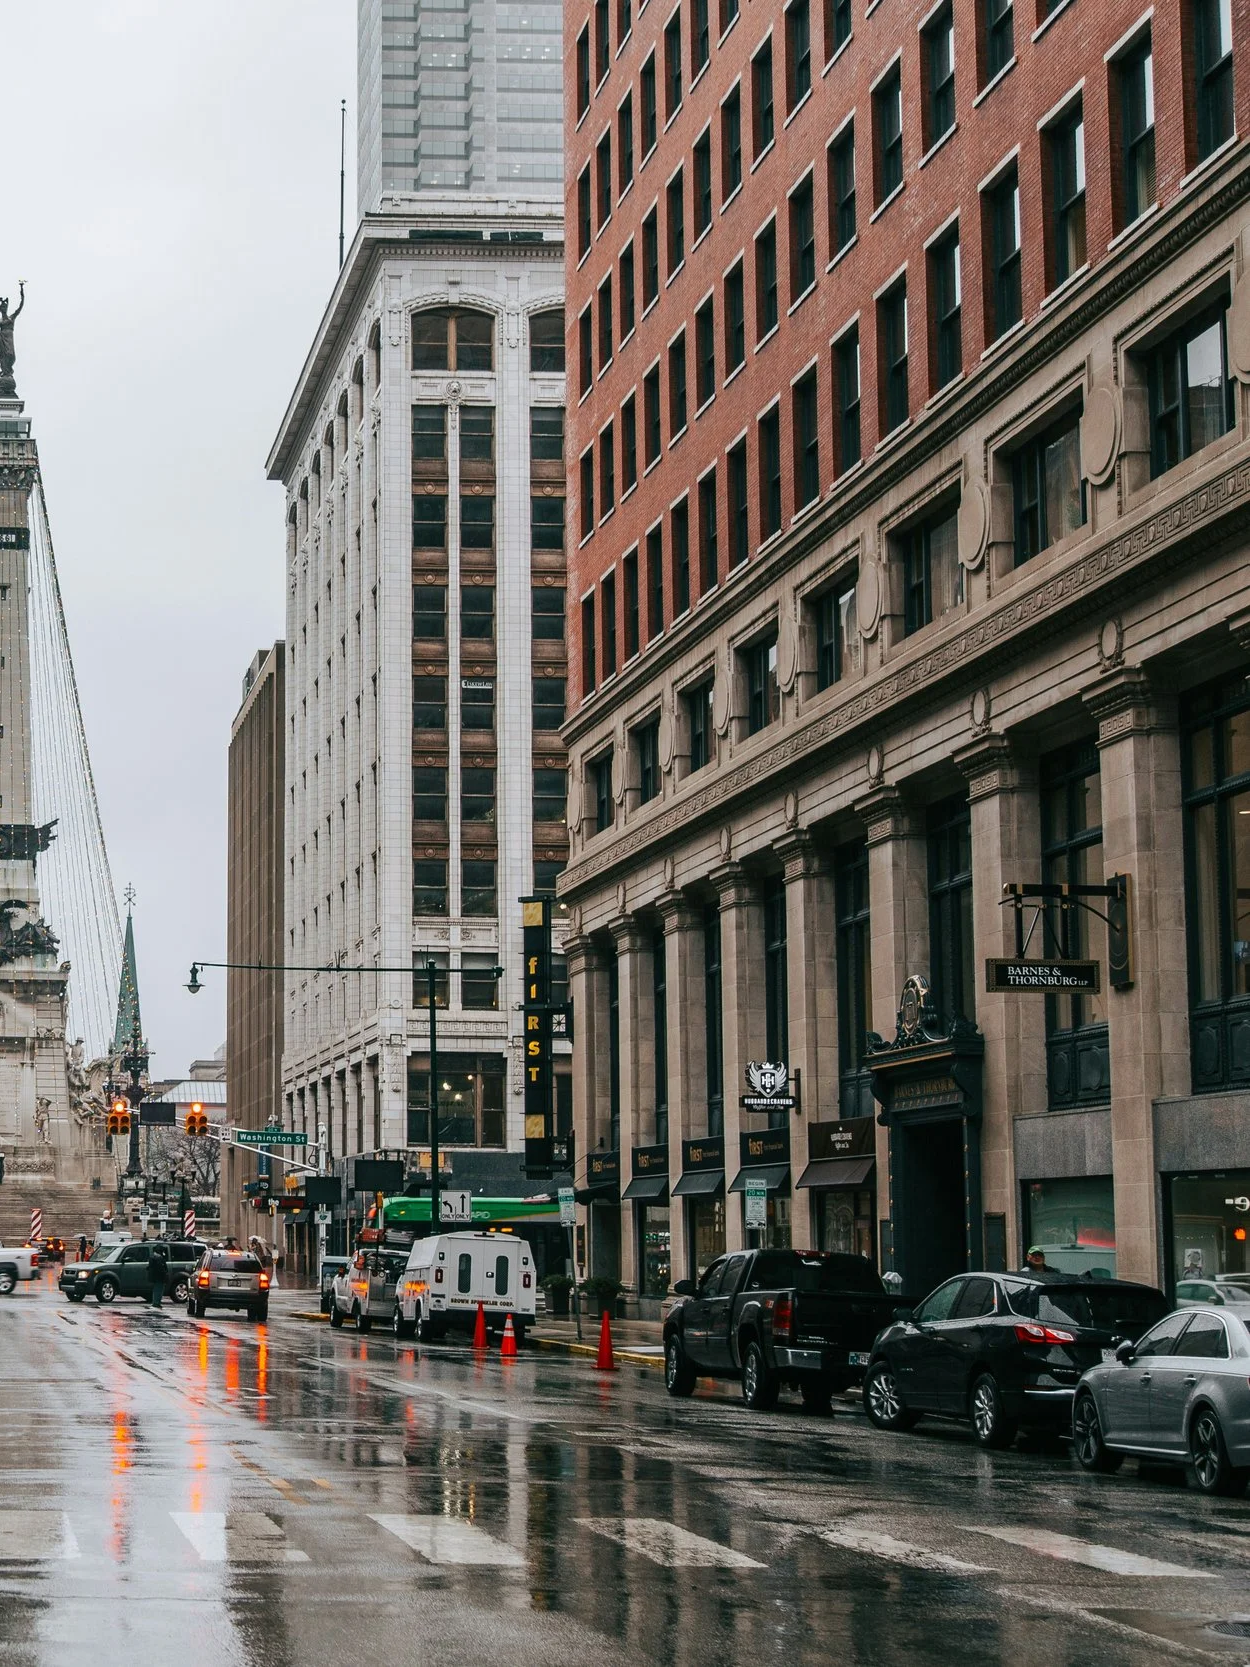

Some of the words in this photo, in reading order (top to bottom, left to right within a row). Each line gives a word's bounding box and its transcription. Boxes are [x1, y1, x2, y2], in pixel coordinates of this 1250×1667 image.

[1007, 966, 1050, 976] BARNES
[1052, 966, 1062, 976] &
[1007, 976, 1077, 986] THORNBURG
[239, 1133, 292, 1144] Washington
[295, 1135, 305, 1143] St
[471, 1211, 490, 1219] APID
